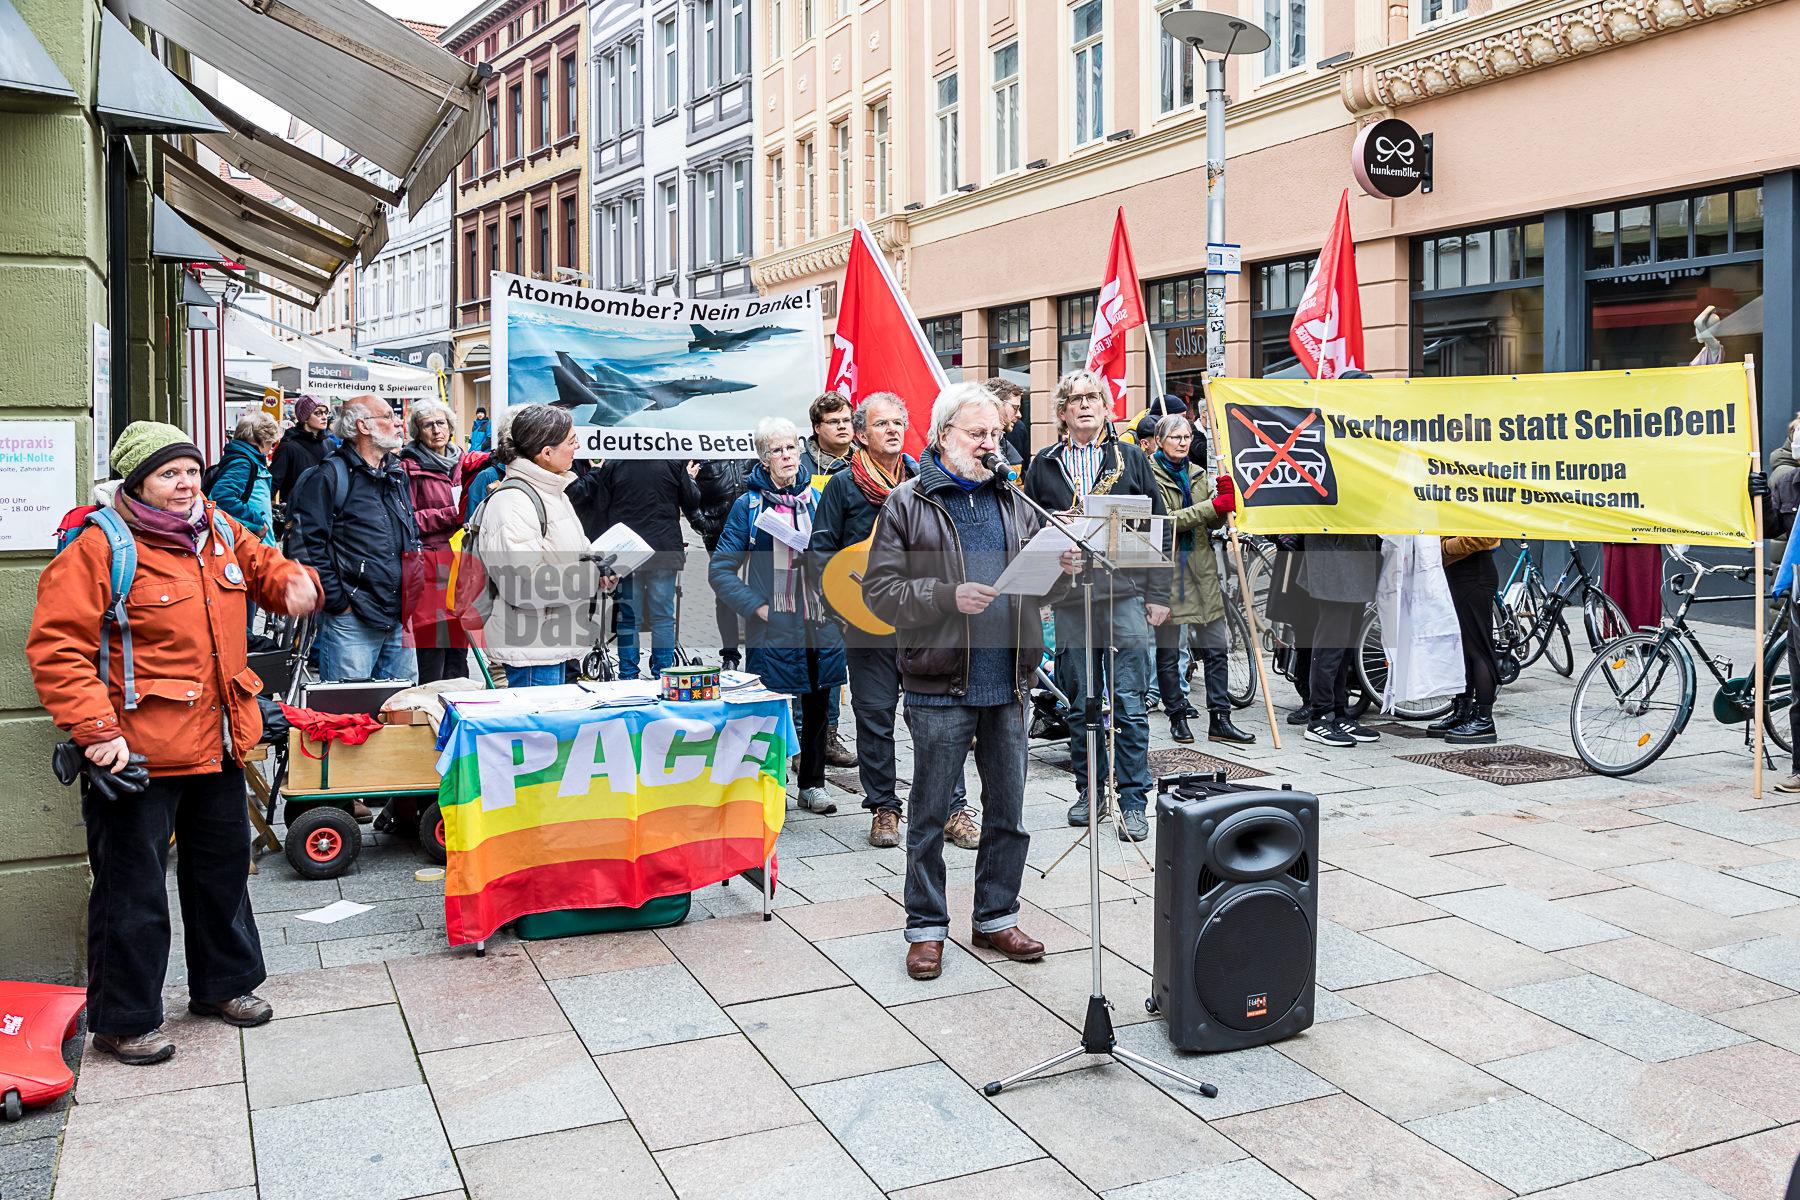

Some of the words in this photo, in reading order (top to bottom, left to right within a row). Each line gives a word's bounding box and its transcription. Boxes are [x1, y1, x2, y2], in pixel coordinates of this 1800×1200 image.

[1370, 163, 1420, 178] hunkemöller
[508, 279, 684, 321] Atombomber?
[690, 303, 740, 321] Nein
[746, 289, 811, 318] Danke!
[308, 381, 376, 392] Kinderkleidung
[387, 384, 433, 392] Spielwaren
[1327, 413, 1492, 442] Verhandeln
[1499, 412, 1568, 442] statt
[1575, 403, 1735, 440] Schießen!
[587, 430, 692, 451] deutsche
[1428, 458, 1527, 480] Sicherheit
[1531, 461, 1550, 480] in
[1555, 460, 1626, 481] Europa
[1414, 484, 1451, 501] gibt
[1456, 486, 1479, 502] es
[1483, 487, 1516, 502] nur
[1521, 488, 1645, 508] gemeinsam.
[476, 715, 780, 813] PACE
